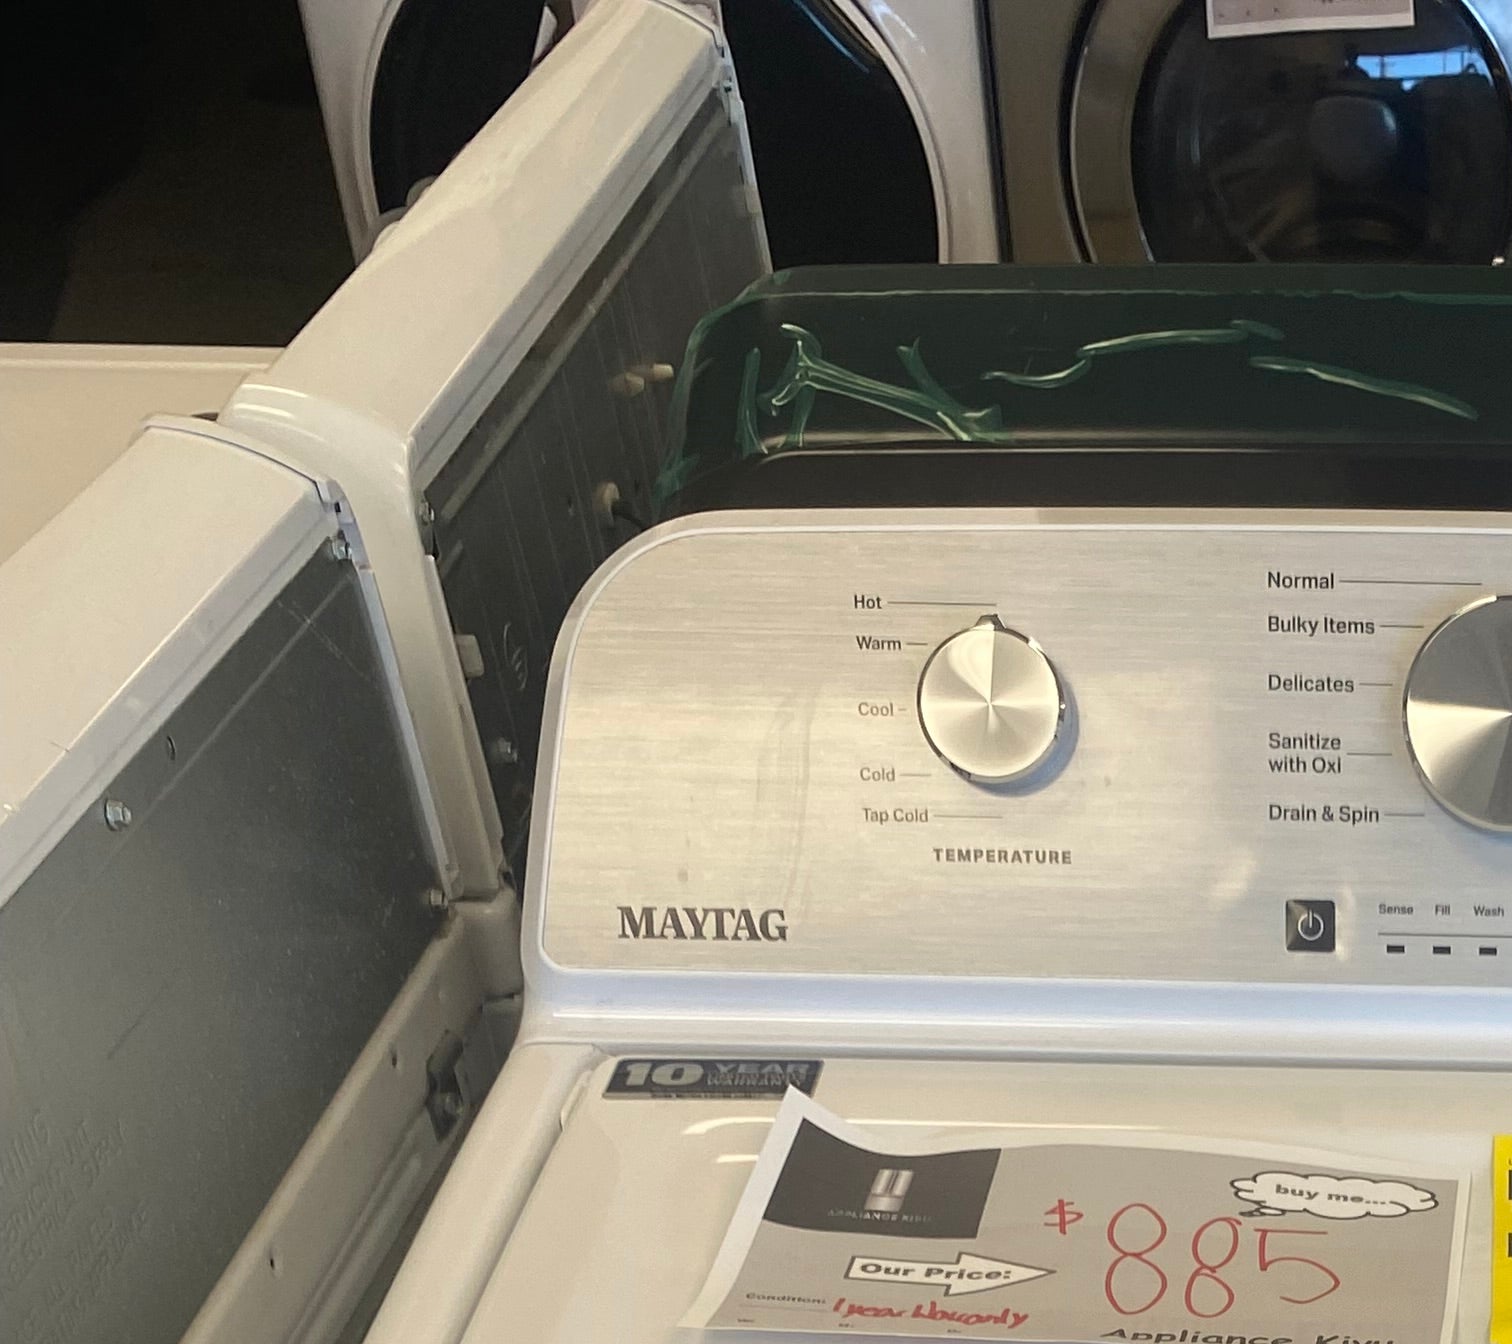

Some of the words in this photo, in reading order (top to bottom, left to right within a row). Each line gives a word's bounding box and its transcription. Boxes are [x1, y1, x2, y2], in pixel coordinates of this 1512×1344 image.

[1267, 572, 1335, 589] Normal
[853, 595, 883, 610] Hot
[1267, 616, 1319, 636] Bulky
[1324, 617, 1375, 634] Items
[856, 636, 902, 651] Warm
[1267, 675, 1354, 692] Delicates
[858, 702, 894, 717] Cool
[1268, 733, 1341, 751] Sanitize
[1268, 756, 1307, 773] with
[1312, 757, 1341, 774] Oxi
[860, 767, 895, 782] Cold
[863, 807, 889, 825] Tap
[893, 808, 928, 823] Cold
[1269, 805, 1317, 821] Drain
[1322, 806, 1334, 821] &
[1339, 806, 1380, 825] Spin
[933, 848, 1072, 865] TEMPERATURE
[1379, 904, 1414, 915] Sense
[1435, 905, 1450, 915] Fill
[1473, 906, 1504, 917] Wash
[617, 906, 788, 941] MAYTAG
[625, 1062, 704, 1086] 10
[1275, 1185, 1319, 1200] buy
[861, 1263, 915, 1276] Our
[924, 1267, 1012, 1280] Price:
